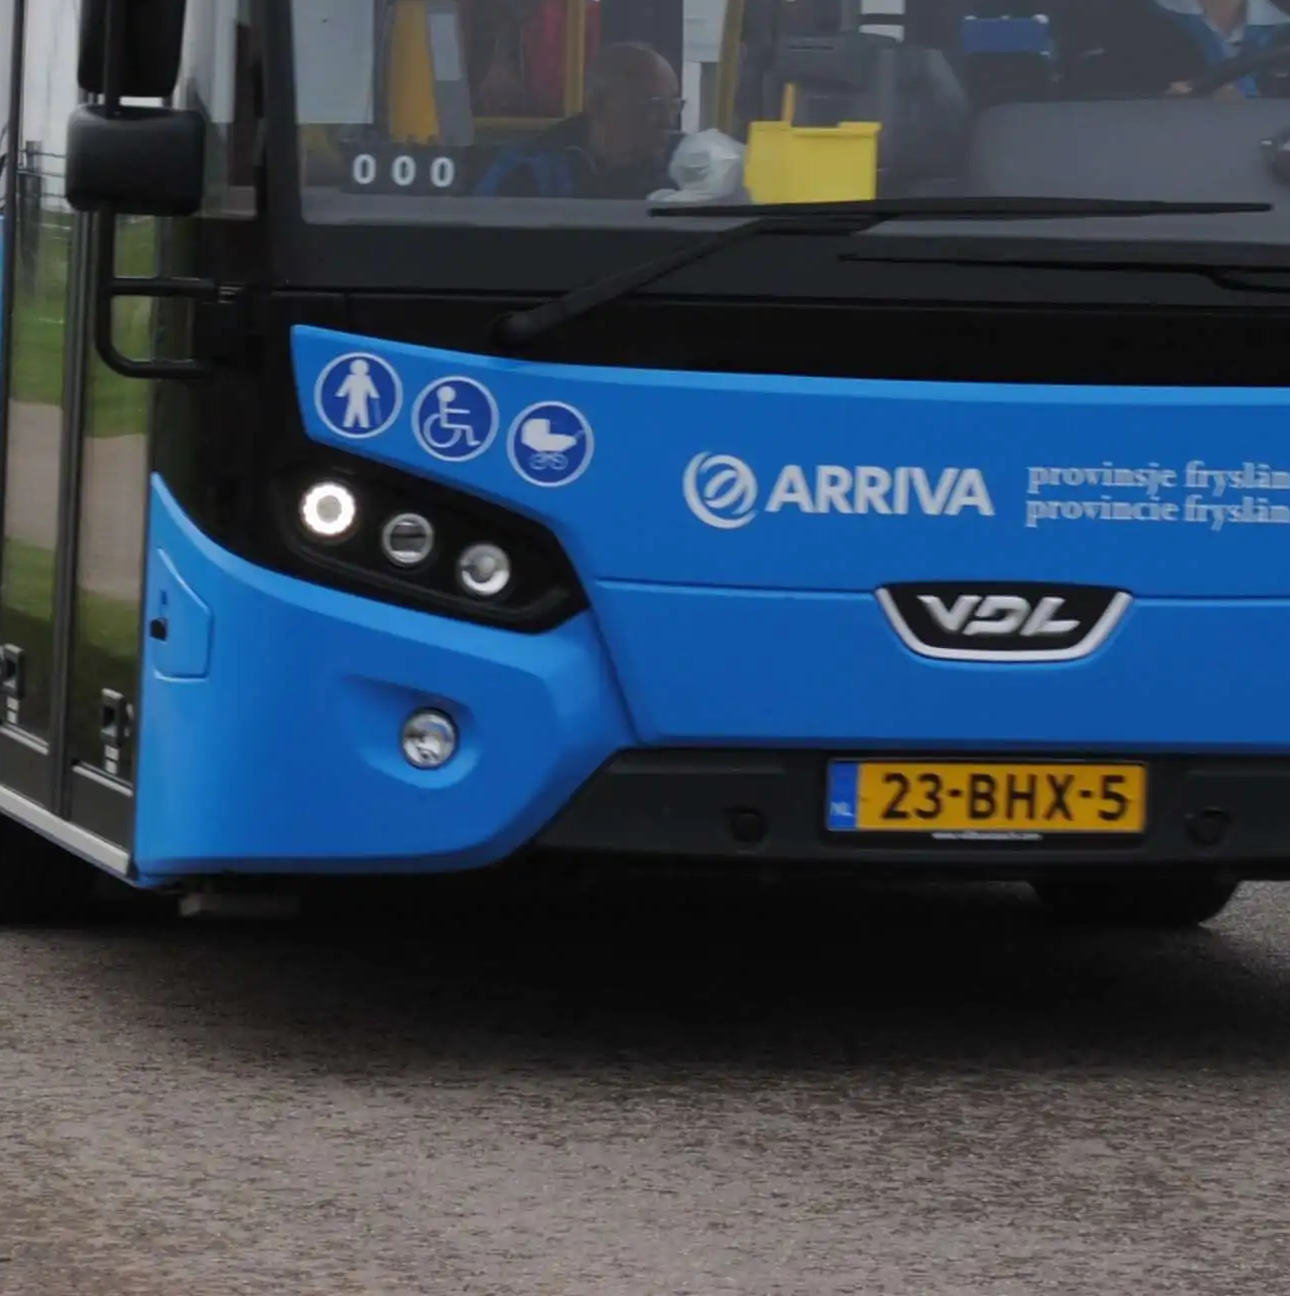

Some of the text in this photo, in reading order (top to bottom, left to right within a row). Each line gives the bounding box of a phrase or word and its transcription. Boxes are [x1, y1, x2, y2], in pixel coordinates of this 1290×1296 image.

[764, 463, 996, 517] ARRIVA
[1025, 461, 1178, 496] provinsje
[1024, 495, 1180, 529] provincie
[915, 594, 1082, 637] VDL
[879, 771, 1130, 822] 23-BHX-5
